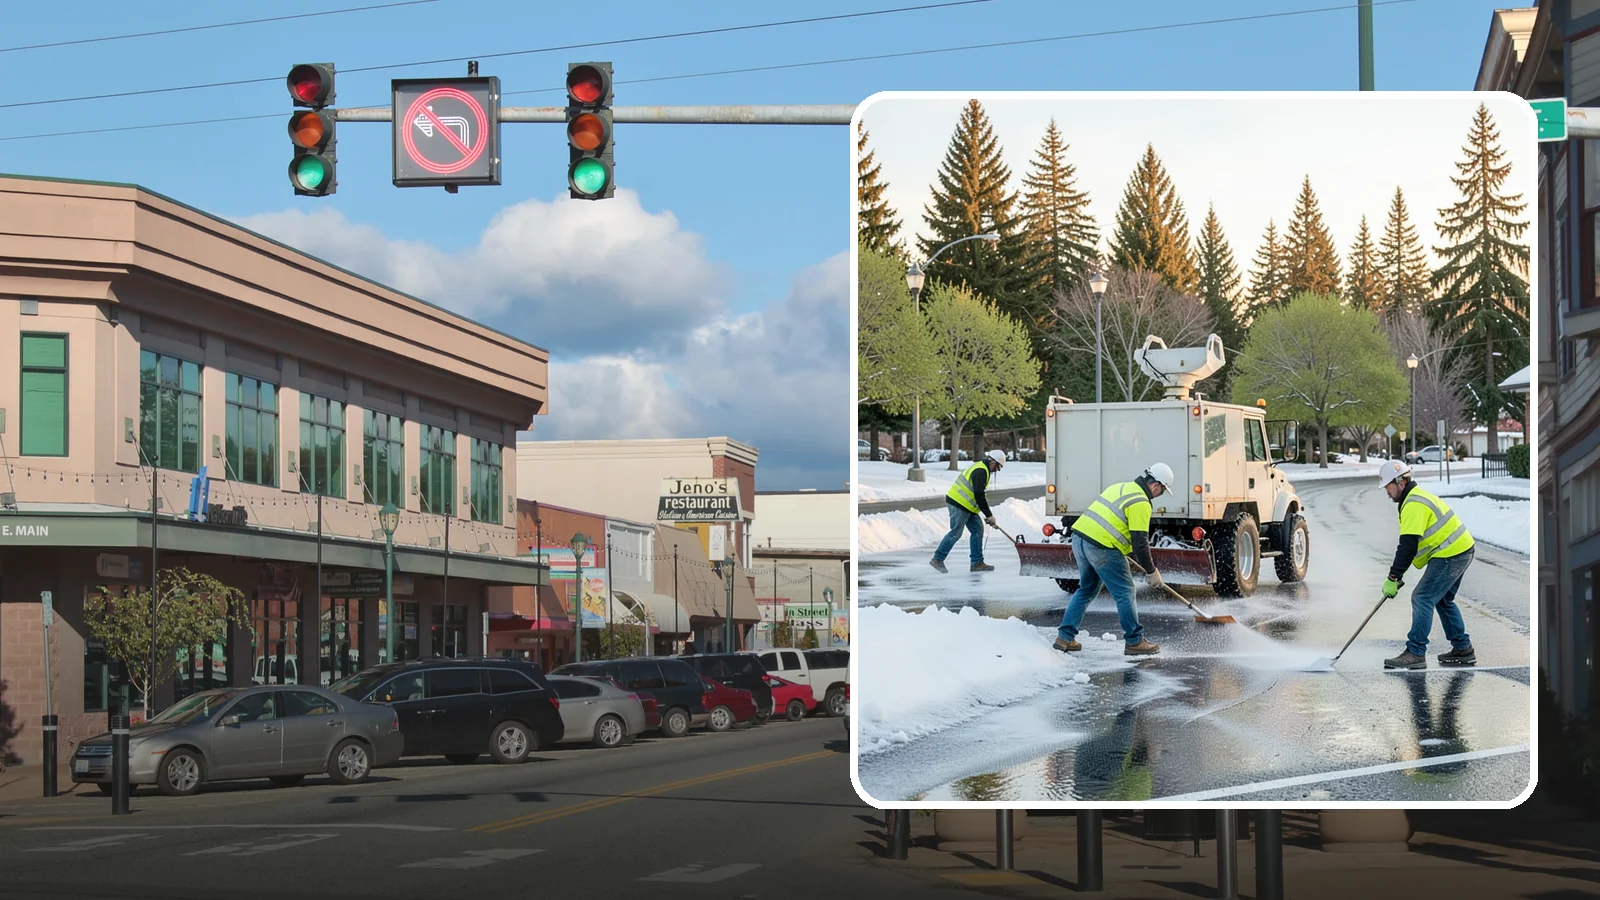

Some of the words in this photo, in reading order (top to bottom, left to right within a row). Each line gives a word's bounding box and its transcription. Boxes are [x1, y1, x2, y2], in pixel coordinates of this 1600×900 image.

[670, 480, 727, 494] Jeno's
[665, 497, 730, 508] restaurant
[686, 510, 714, 519] American
[715, 510, 737, 519] Cuisine
[2, 525, 13, 536] E.
[15, 525, 49, 536] MAIN
[797, 608, 828, 616] Street
[790, 619, 824, 627] lass
